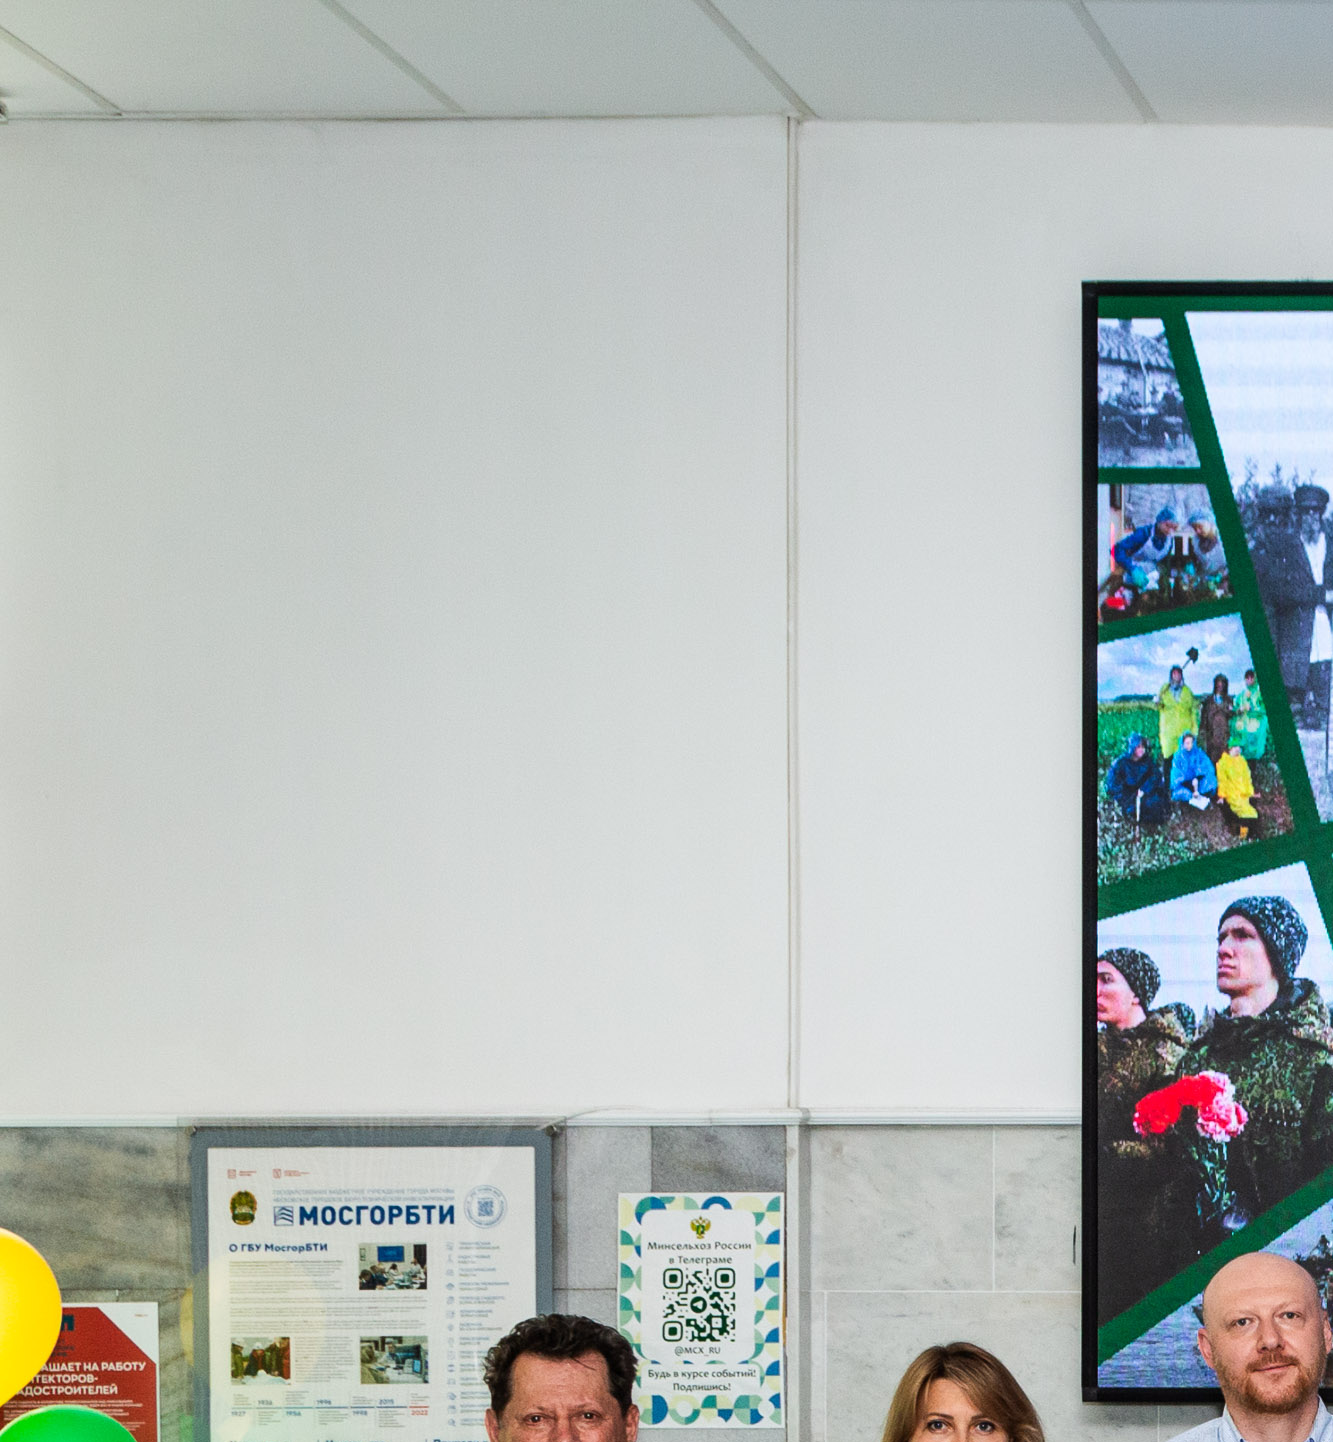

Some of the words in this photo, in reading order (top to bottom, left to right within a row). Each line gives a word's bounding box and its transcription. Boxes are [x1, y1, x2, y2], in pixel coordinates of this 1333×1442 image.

[299, 1205, 455, 1226] МОСГОРБТИ
[229, 1243, 238, 1252] О
[241, 1243, 261, 1252] ГБУ
[264, 1243, 328, 1253] МосгорБТИ
[647, 1242, 711, 1250] Минсельхоз
[715, 1242, 751, 1250] России
[678, 1256, 733, 1266] Телеграме
[40, 1362, 81, 1371] АШАЕТ
[83, 1362, 102, 1371] НА
[101, 1362, 146, 1371] РАБОТУ
[32, 1374, 98, 1383] ТЕКТОРОВ-
[648, 1369, 671, 1379] Будь
[682, 1372, 709, 1380] курсе
[712, 1369, 756, 1377] событий!
[17, 1383, 118, 1396] АДОСТРОИТЕЛЕЙ
[673, 1383, 731, 1392] Подпишись!
